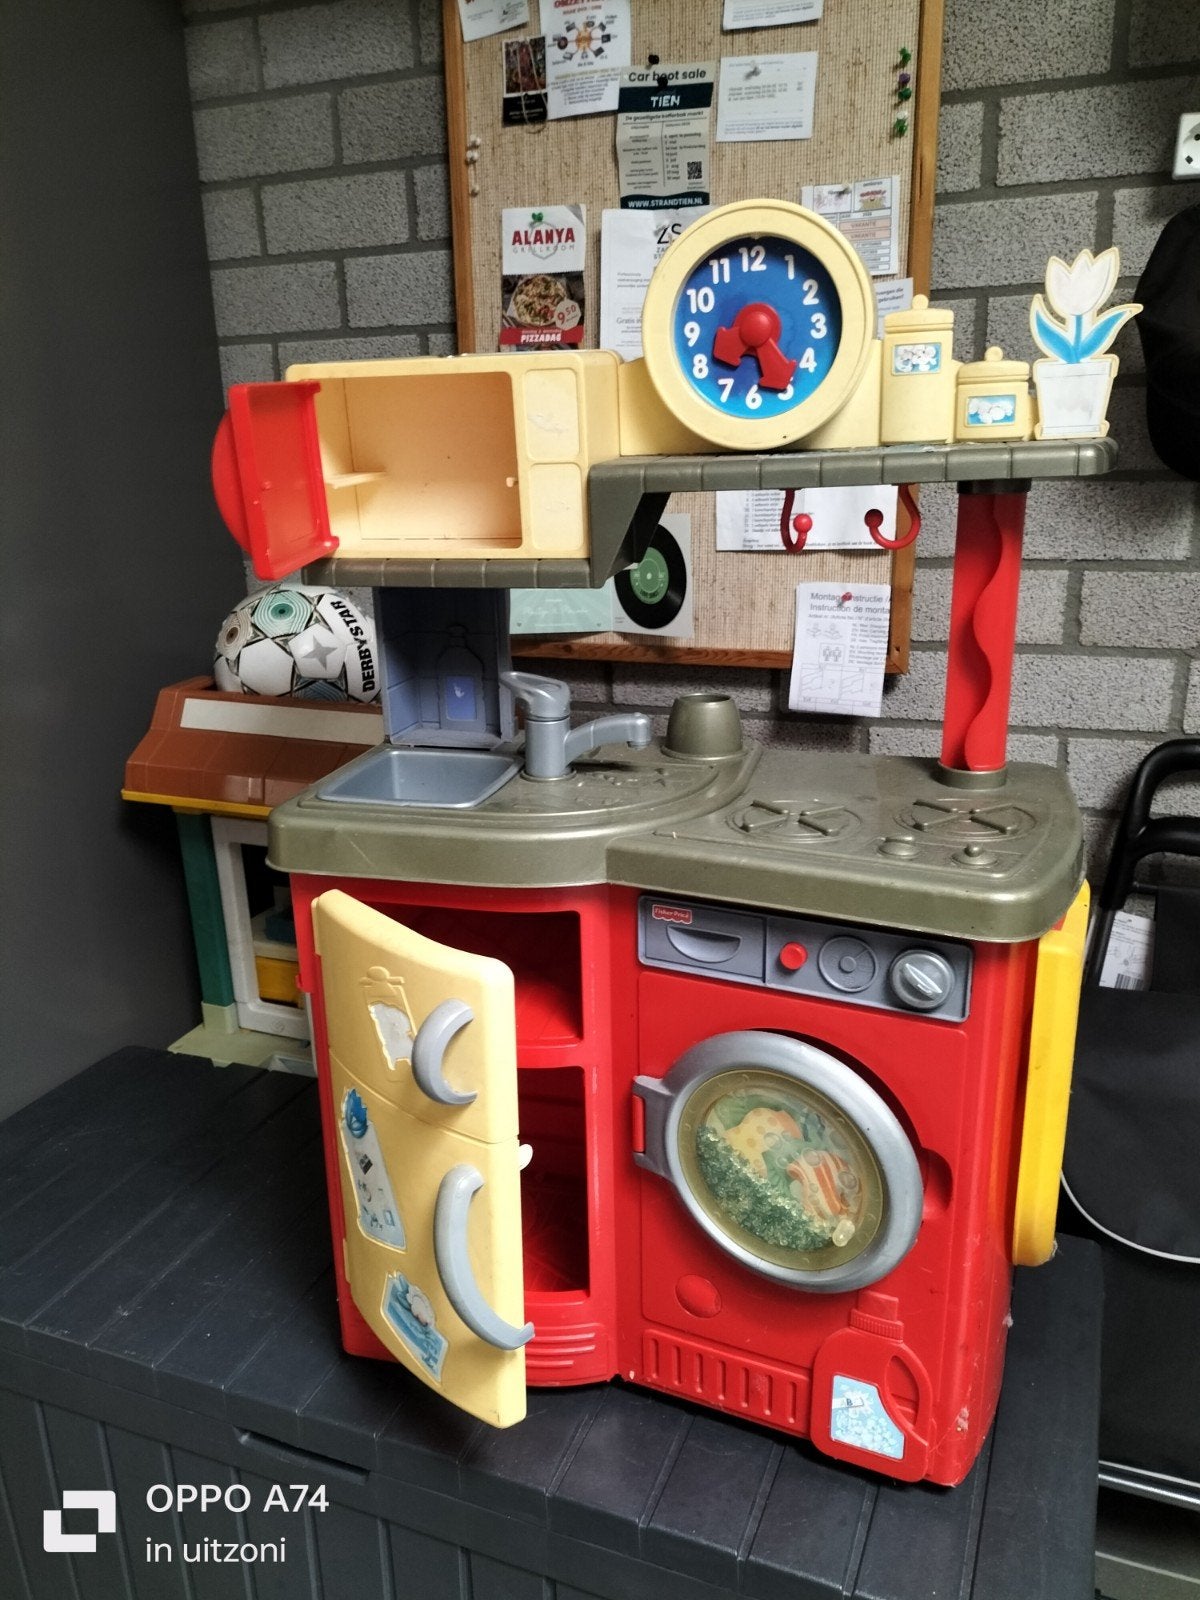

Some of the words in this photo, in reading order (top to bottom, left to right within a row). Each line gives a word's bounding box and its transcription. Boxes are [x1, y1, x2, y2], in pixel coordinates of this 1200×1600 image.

[628, 72, 650, 82] Car
[652, 71, 680, 81] boot
[682, 69, 706, 80] sale
[650, 95, 680, 108] TIEN
[628, 197, 703, 208] WWW.STRANDTIEN.NL
[511, 228, 576, 246] ALANYA
[512, 244, 575, 254] GRILLROOM
[709, 258, 730, 284] 11
[738, 245, 767, 273] 12
[784, 254, 795, 280] 1
[686, 286, 715, 314] 10
[802, 279, 819, 305] 2
[616, 317, 635, 325] Gratis
[684, 321, 700, 347] 9
[810, 312, 827, 339] 3
[692, 353, 709, 379] 8
[799, 347, 817, 373] 4
[717, 378, 734, 403] 7
[745, 384, 762, 409] 6
[330, 600, 375, 693] DERBYSTAR
[654, 907, 689, 918] Fisher-Price
